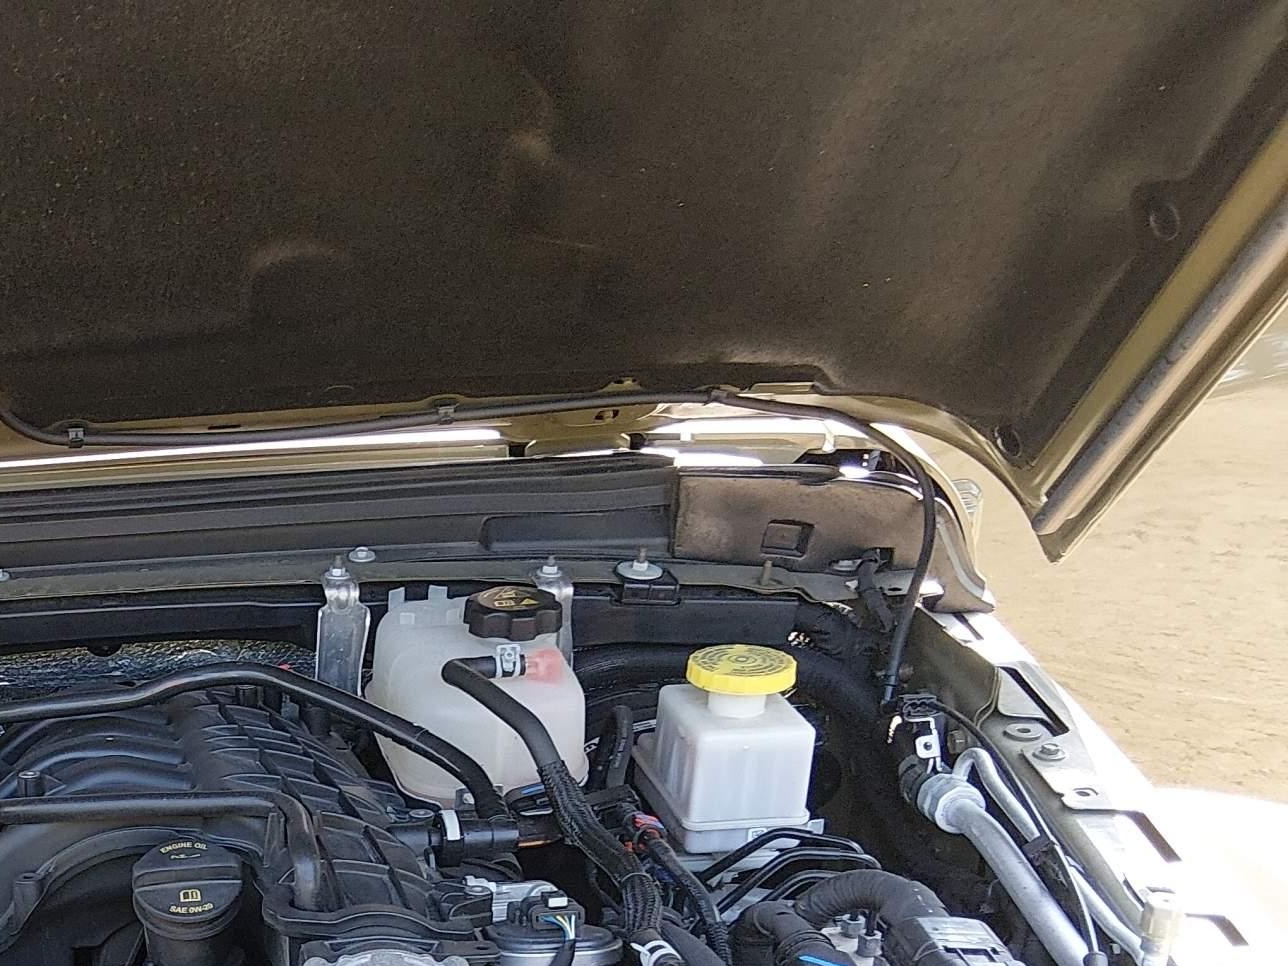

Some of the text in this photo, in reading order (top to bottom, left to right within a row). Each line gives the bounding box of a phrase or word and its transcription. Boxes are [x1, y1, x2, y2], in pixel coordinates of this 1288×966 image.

[159, 841, 208, 854] ENGINE OIL
[169, 902, 214, 914] SAE 0W-20
